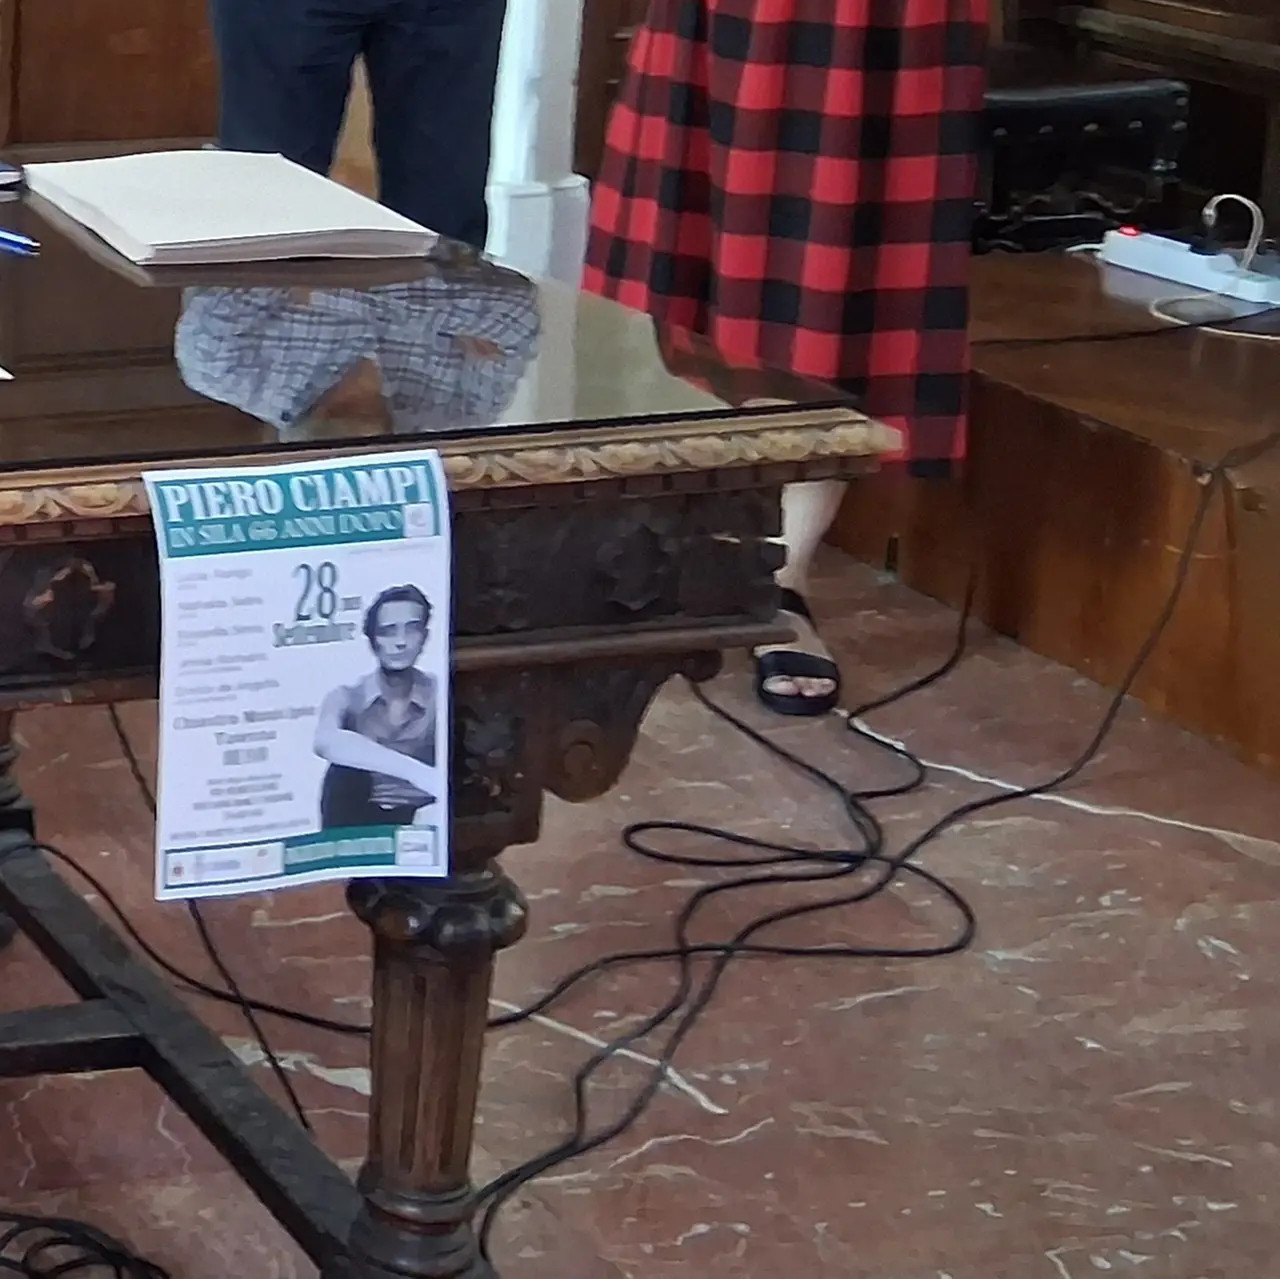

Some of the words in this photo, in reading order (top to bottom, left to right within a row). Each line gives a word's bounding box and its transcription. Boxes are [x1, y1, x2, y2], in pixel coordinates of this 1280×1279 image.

[160, 479, 284, 522] PIERO
[290, 465, 431, 511] CIAMPI
[291, 561, 337, 621] 28
